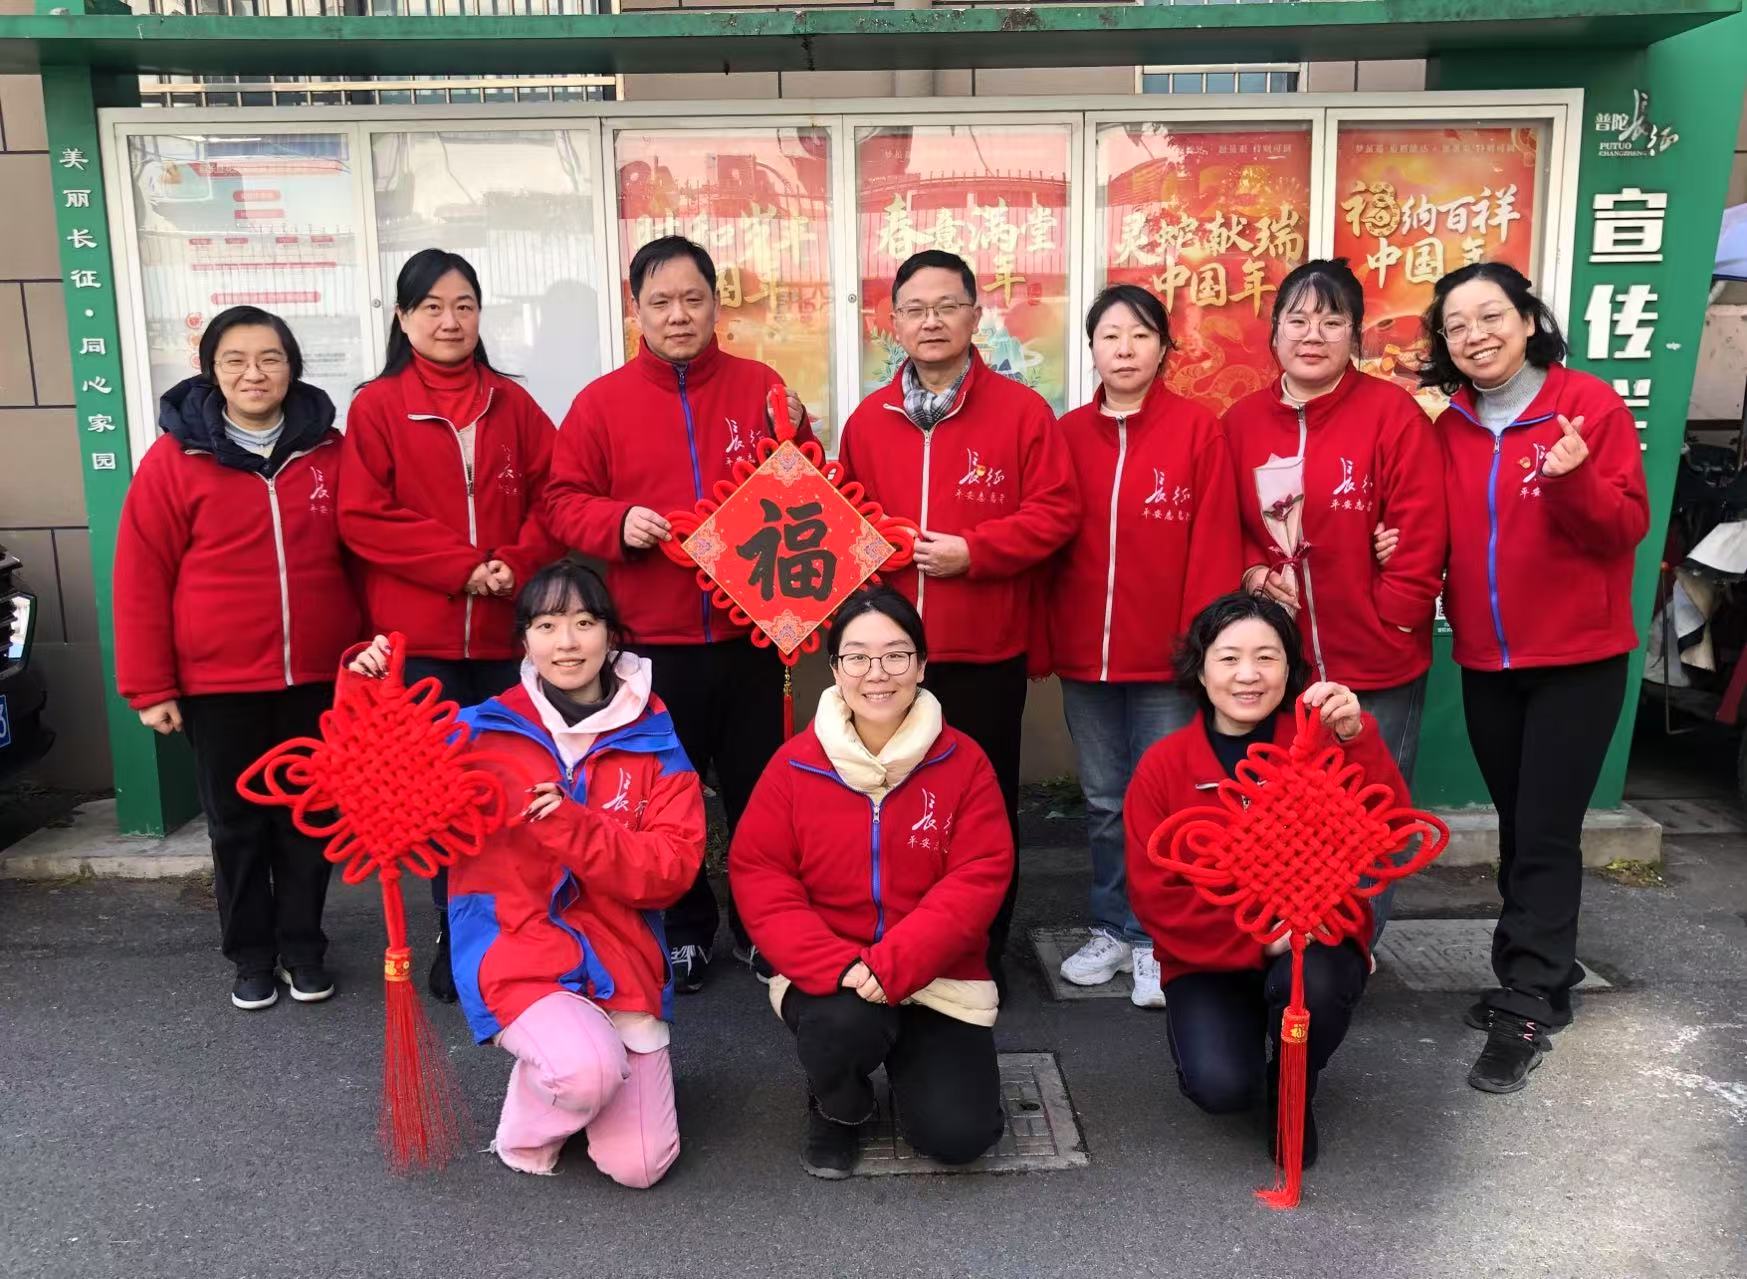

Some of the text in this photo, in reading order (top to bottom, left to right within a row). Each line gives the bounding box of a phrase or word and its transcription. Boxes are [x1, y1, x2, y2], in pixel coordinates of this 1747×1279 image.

[1600, 142, 1632, 150] PUTUO
[1152, 256, 1277, 319] 中国年
[736, 498, 837, 601] 福
